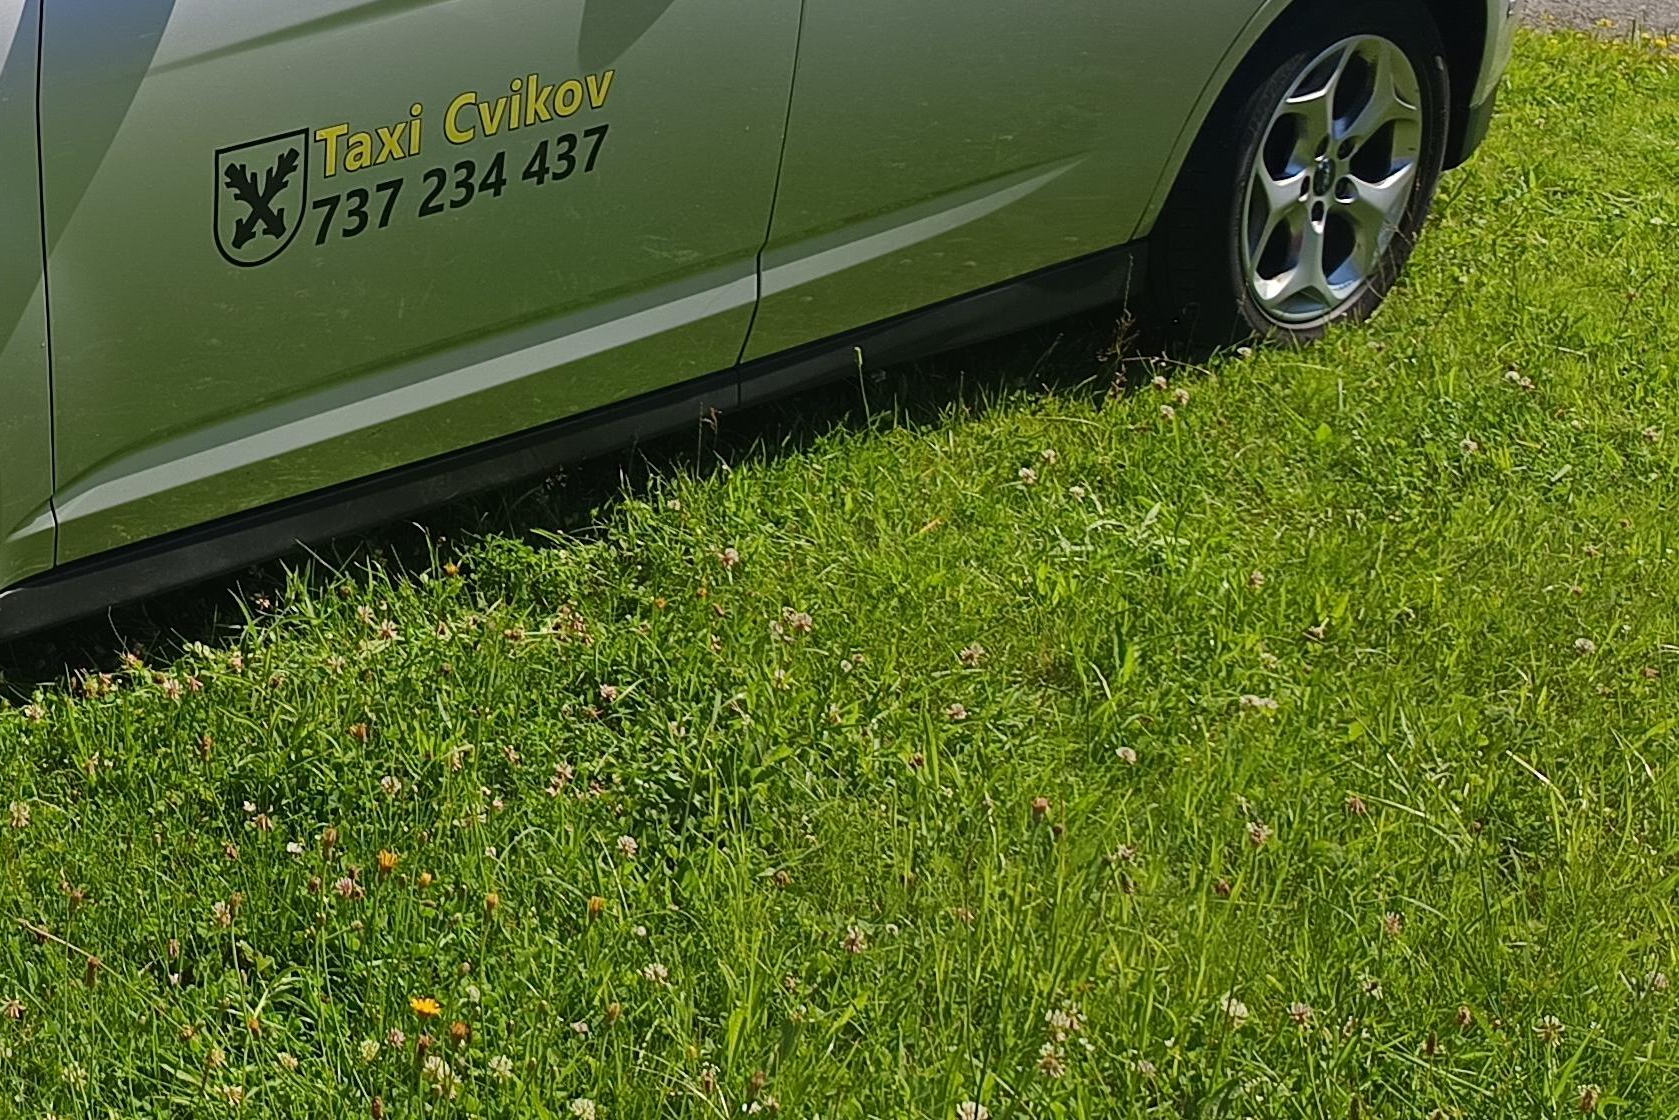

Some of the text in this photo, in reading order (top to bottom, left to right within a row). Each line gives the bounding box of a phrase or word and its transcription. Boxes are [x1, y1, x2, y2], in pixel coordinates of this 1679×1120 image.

[314, 69, 615, 179] Taxi Cvikov
[312, 123, 610, 246] 737 234 437
